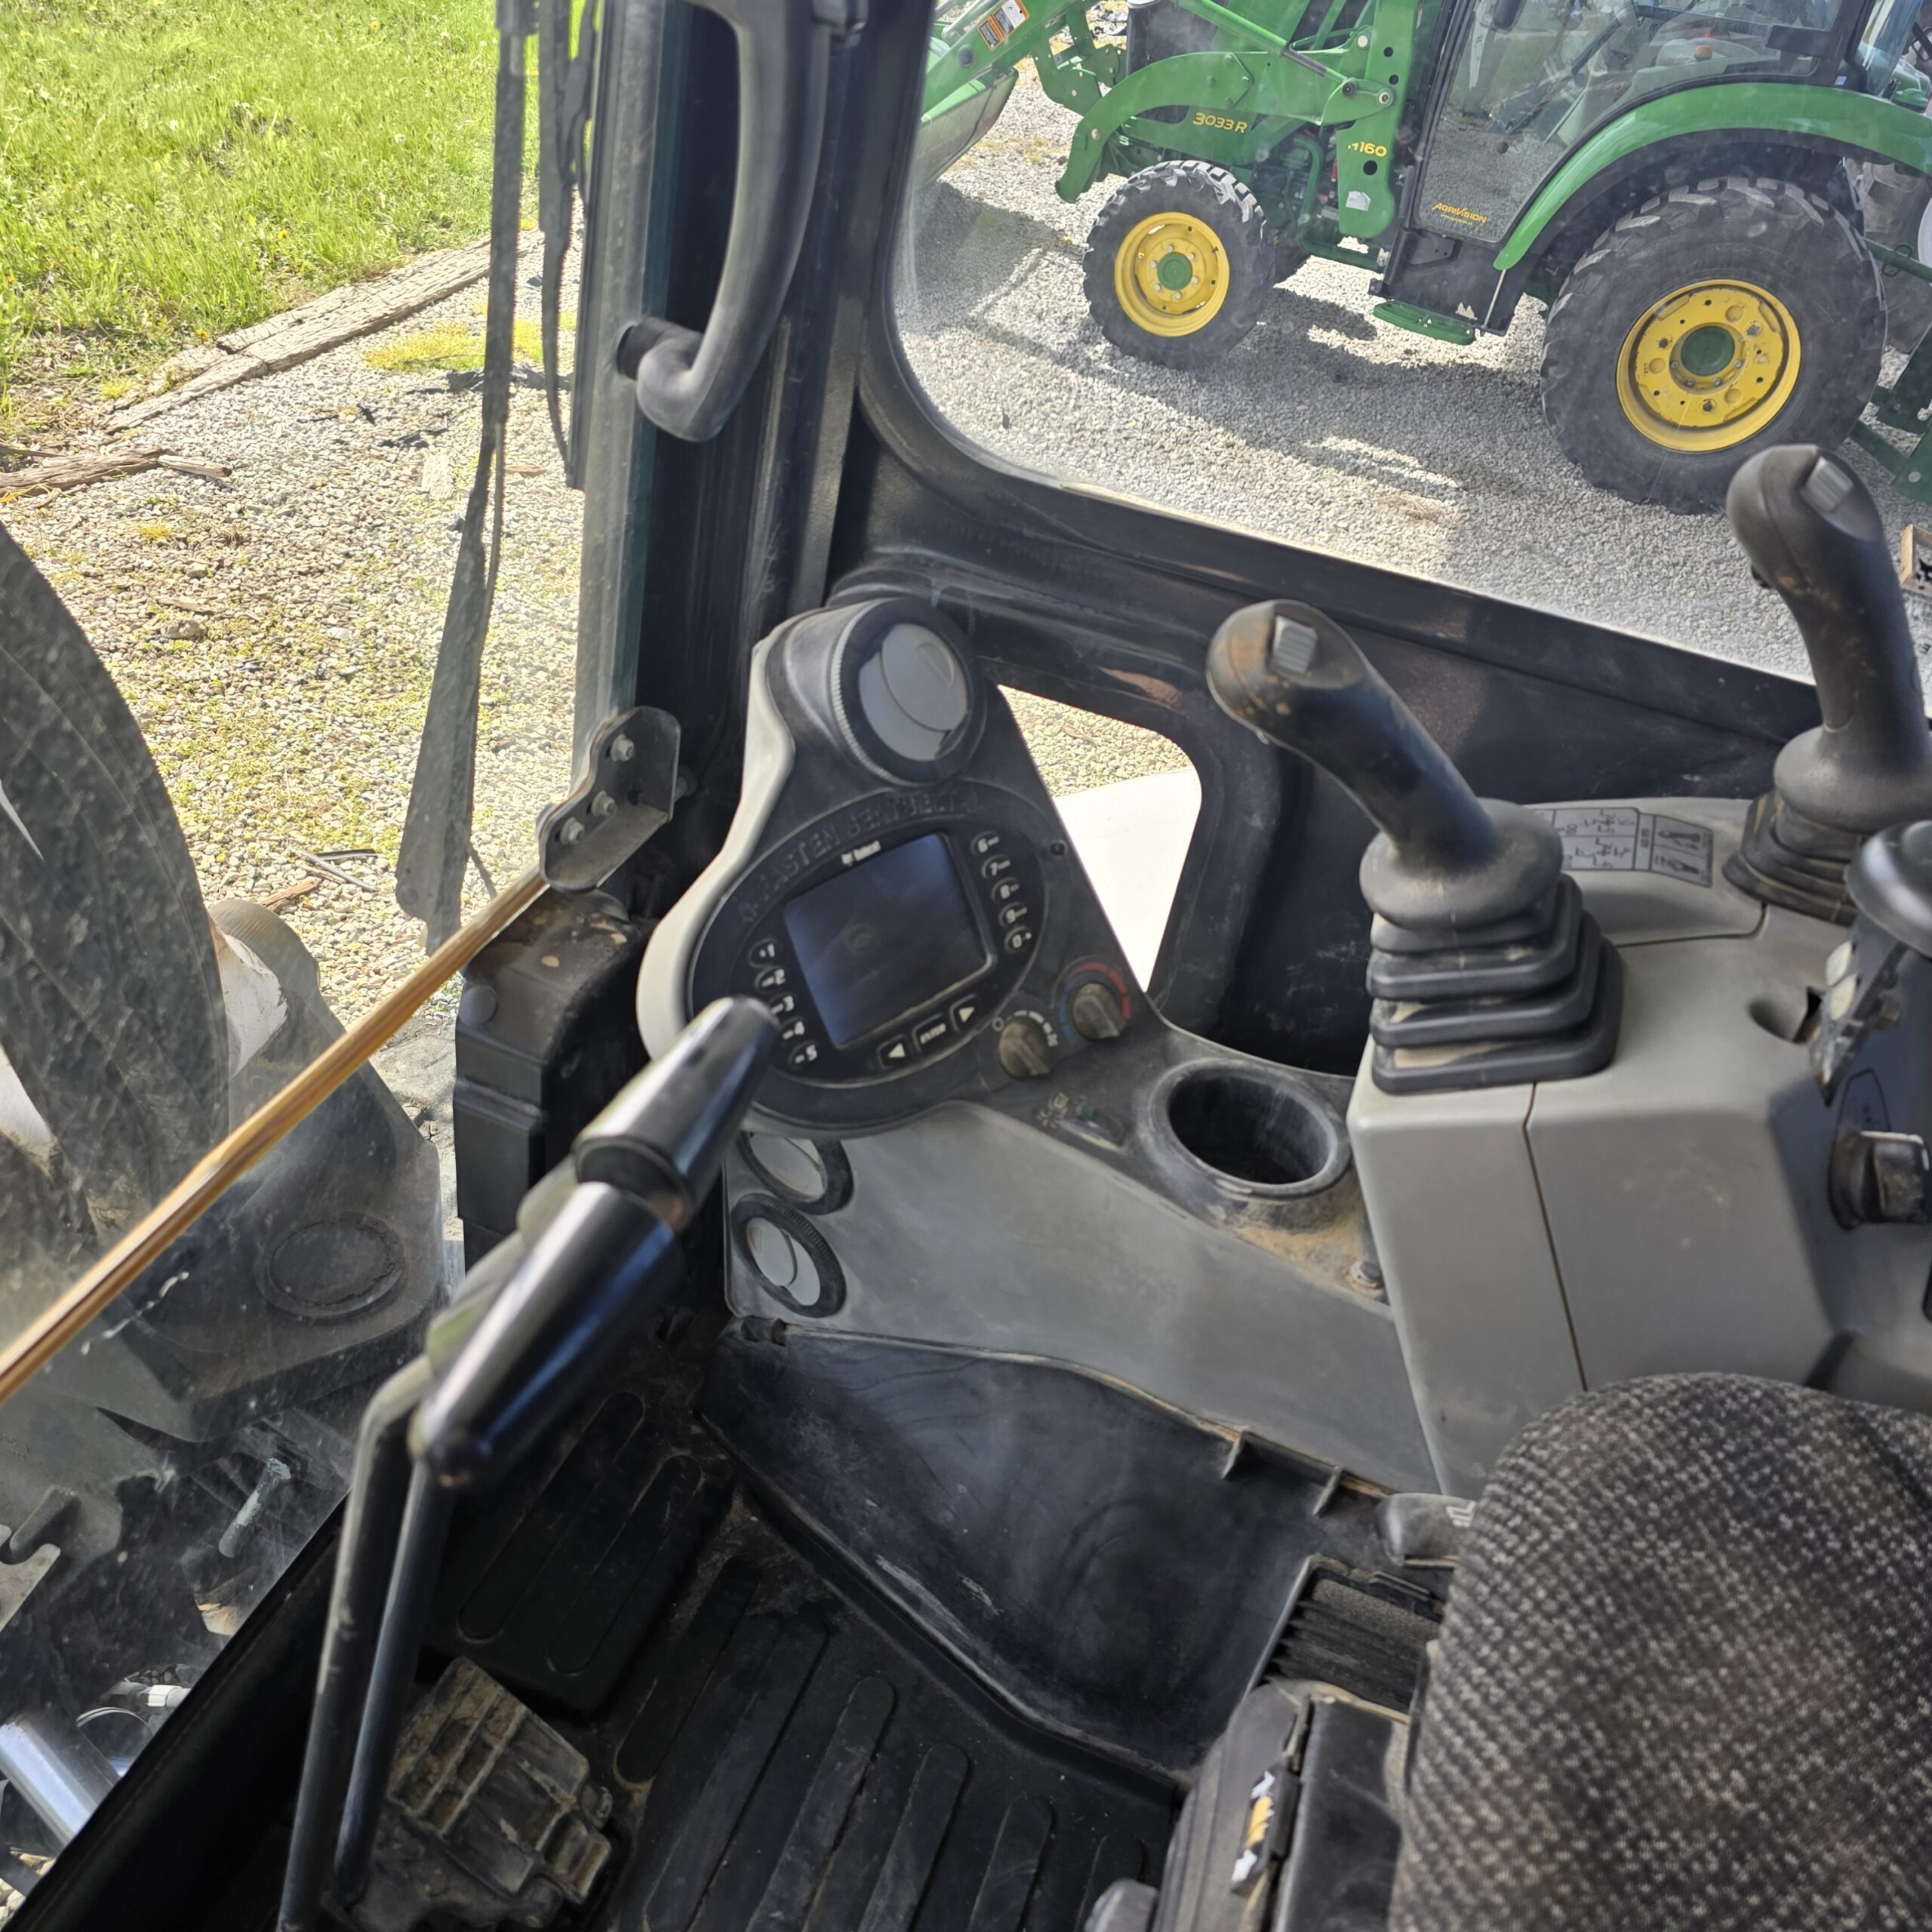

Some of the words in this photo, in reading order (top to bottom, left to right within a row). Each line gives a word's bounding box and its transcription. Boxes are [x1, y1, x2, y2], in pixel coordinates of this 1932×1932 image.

[1192, 112, 1247, 134] 3033R
[978, 838, 988, 853] 6
[989, 861, 998, 876] 7
[1000, 884, 1011, 900] 8
[1006, 909, 1017, 924] 9
[774, 968, 786, 985] 2
[783, 995, 795, 1012] 3
[794, 1020, 805, 1035] 4
[805, 1044, 818, 1061] 5
